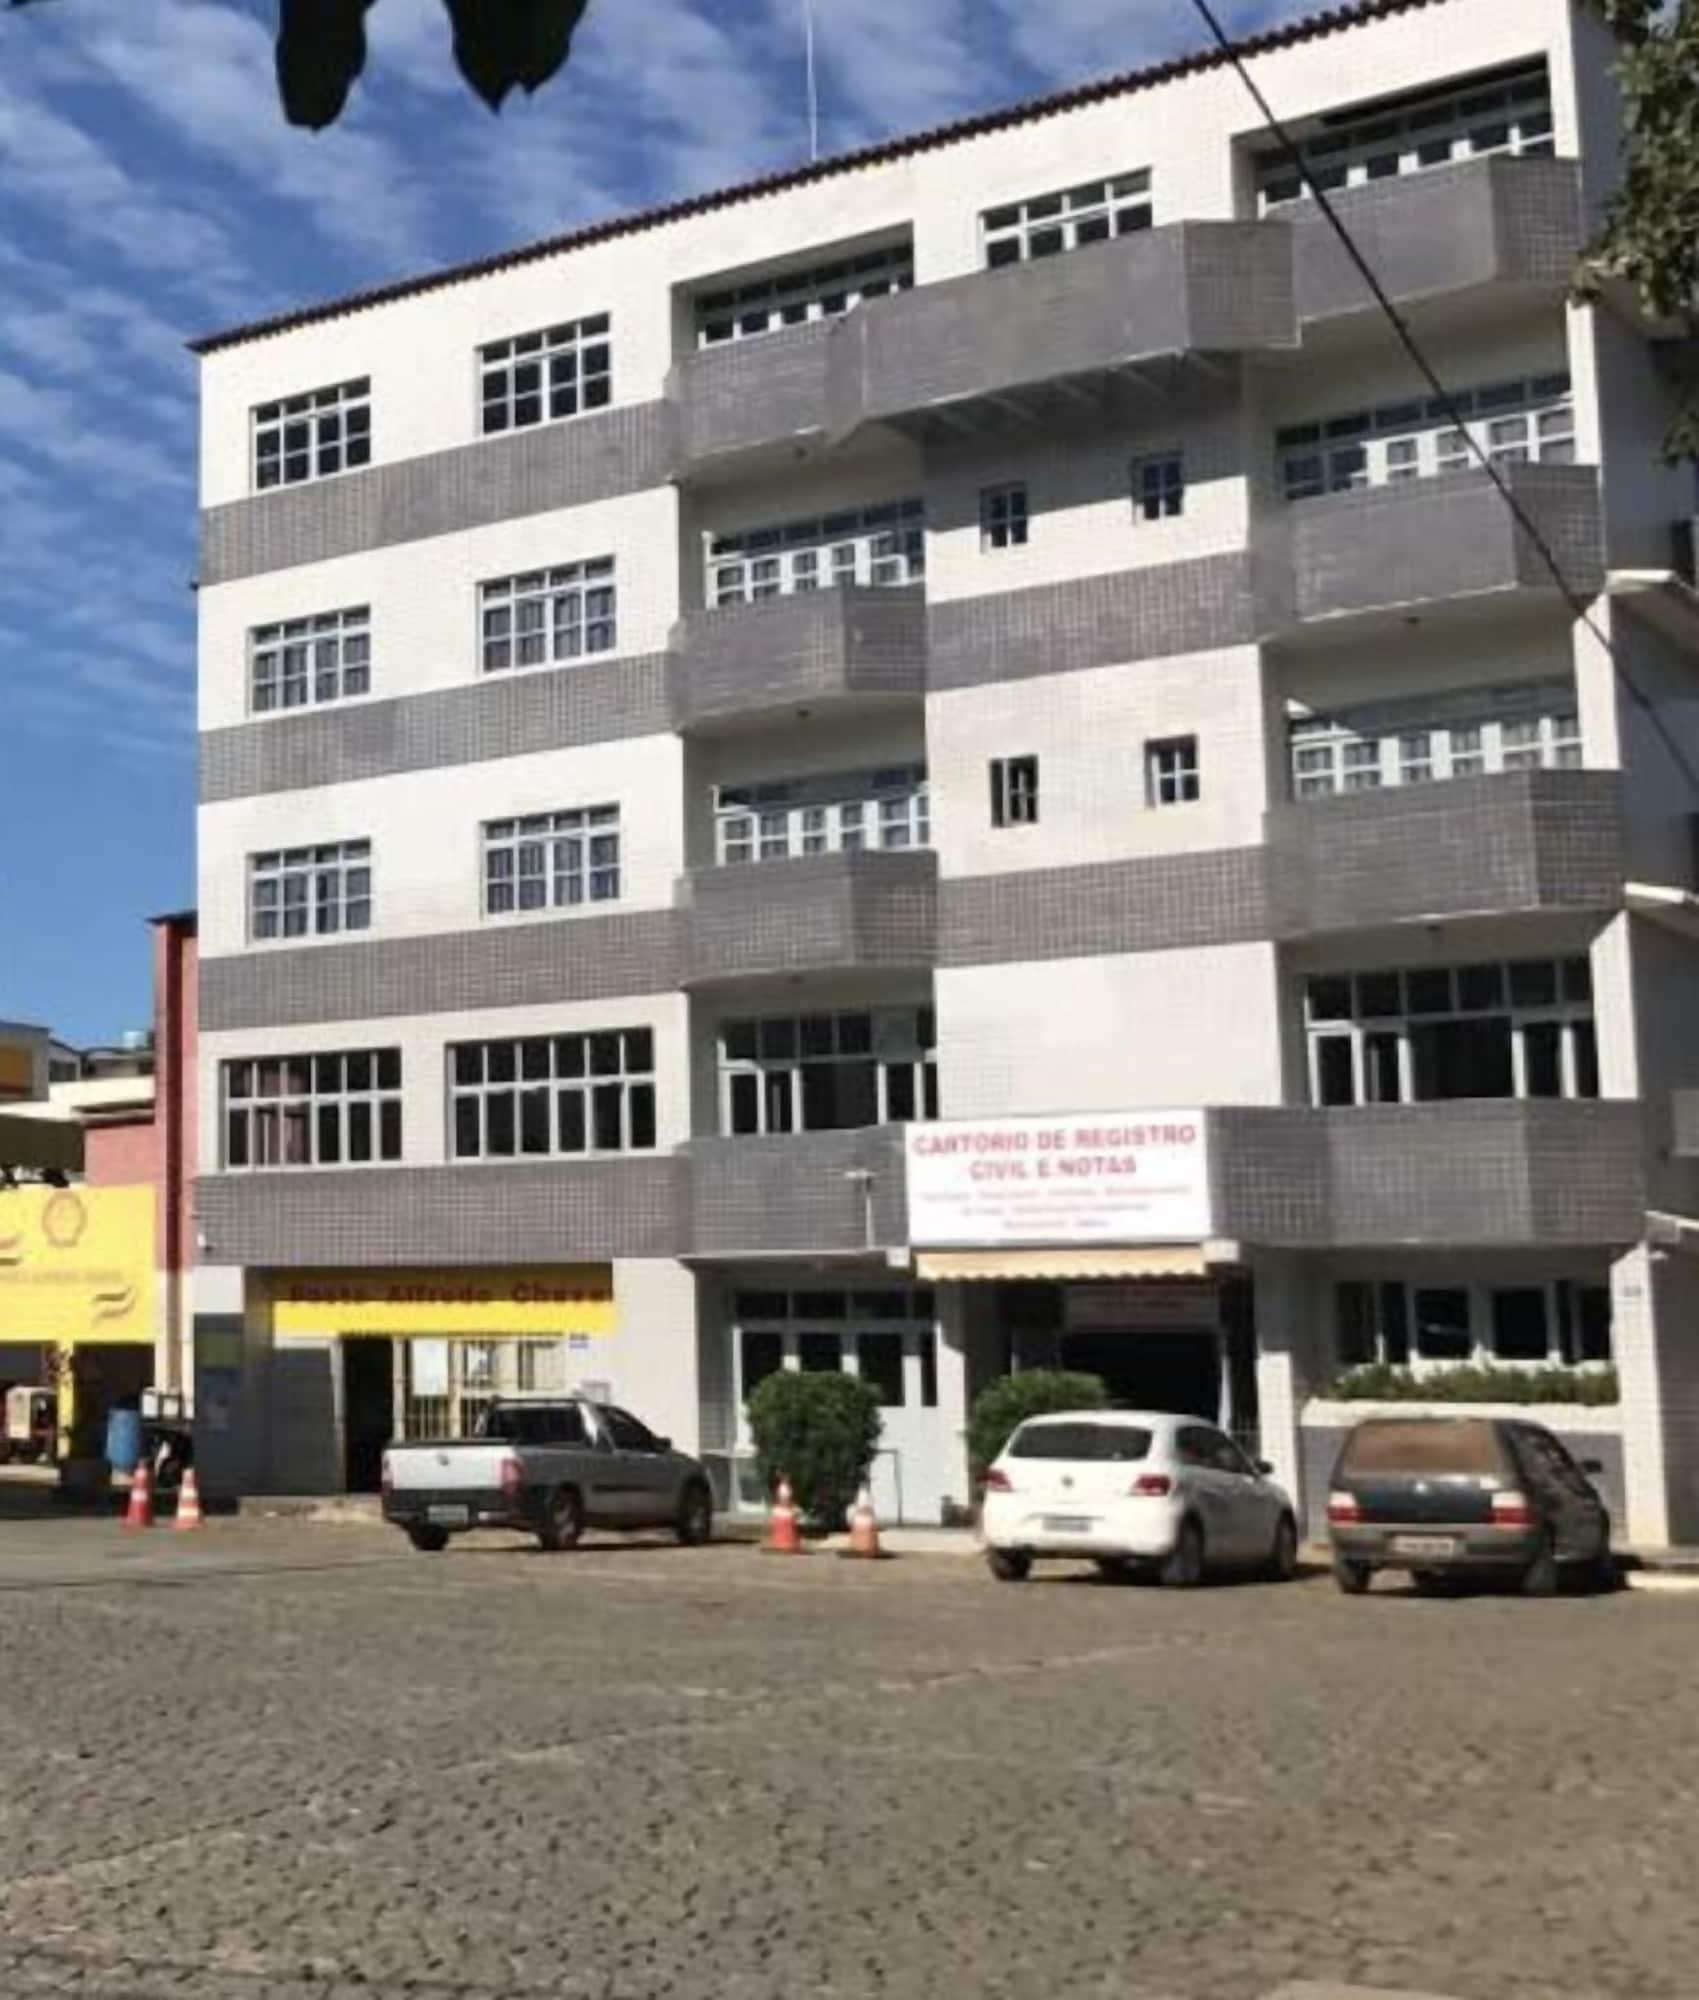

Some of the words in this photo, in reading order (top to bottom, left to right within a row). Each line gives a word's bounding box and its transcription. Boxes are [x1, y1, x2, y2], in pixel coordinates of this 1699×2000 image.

[1037, 1128, 1067, 1151] DE
[1074, 1123, 1197, 1149] REGISTRO
[968, 1157, 1028, 1181] CIVIL
[1037, 1156, 1051, 1179] E
[1056, 1154, 1137, 1178] NOTAS
[385, 1283, 493, 1302] Alfredo
